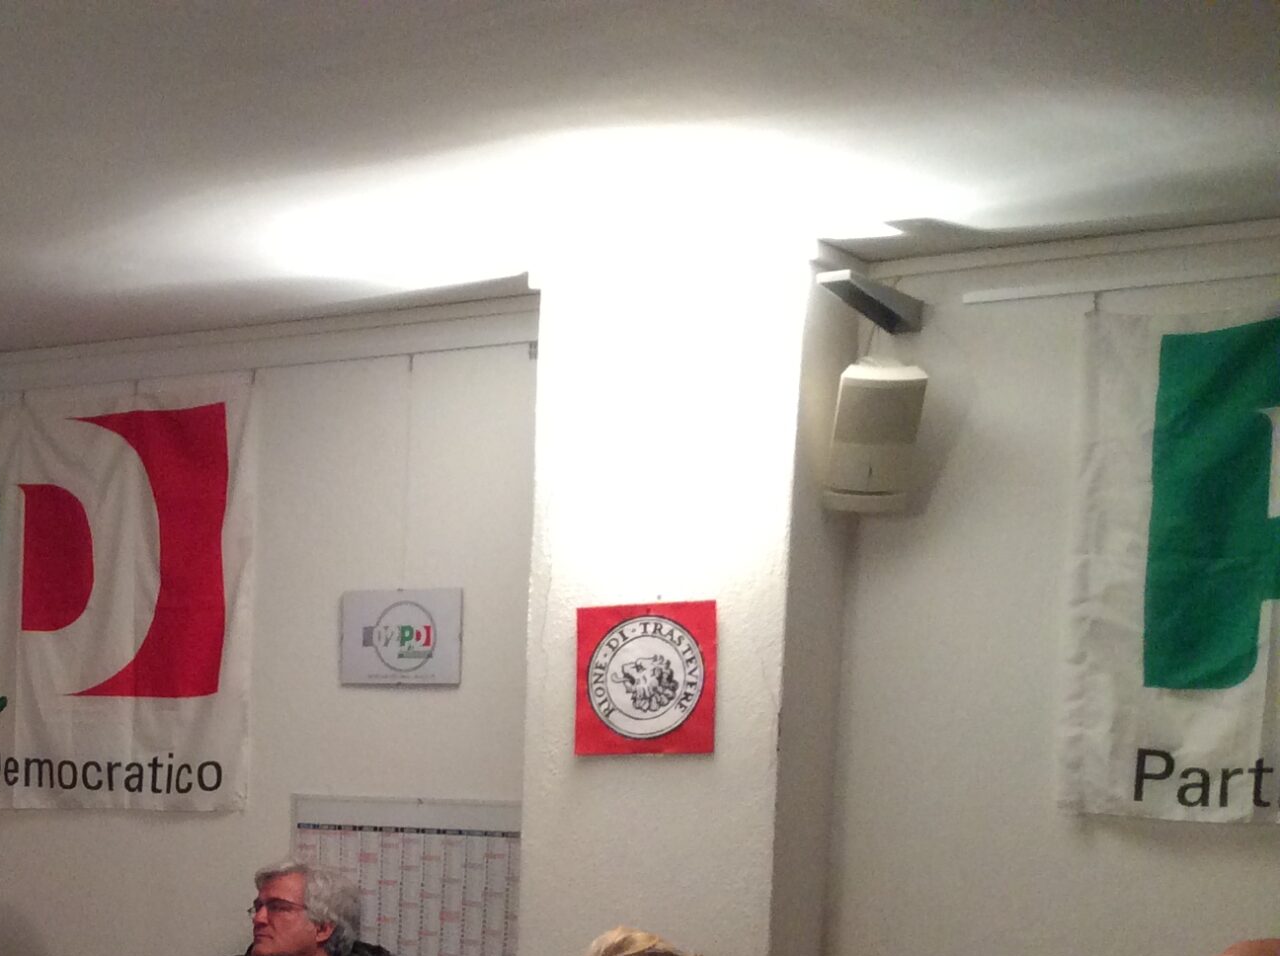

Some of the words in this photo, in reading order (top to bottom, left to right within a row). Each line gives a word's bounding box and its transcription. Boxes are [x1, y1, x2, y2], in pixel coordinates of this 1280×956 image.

[593, 661, 617, 719] RIONE
[606, 629, 630, 652] DI
[639, 621, 699, 714] TRASTEVERE
[1133, 748, 1280, 808] Part
